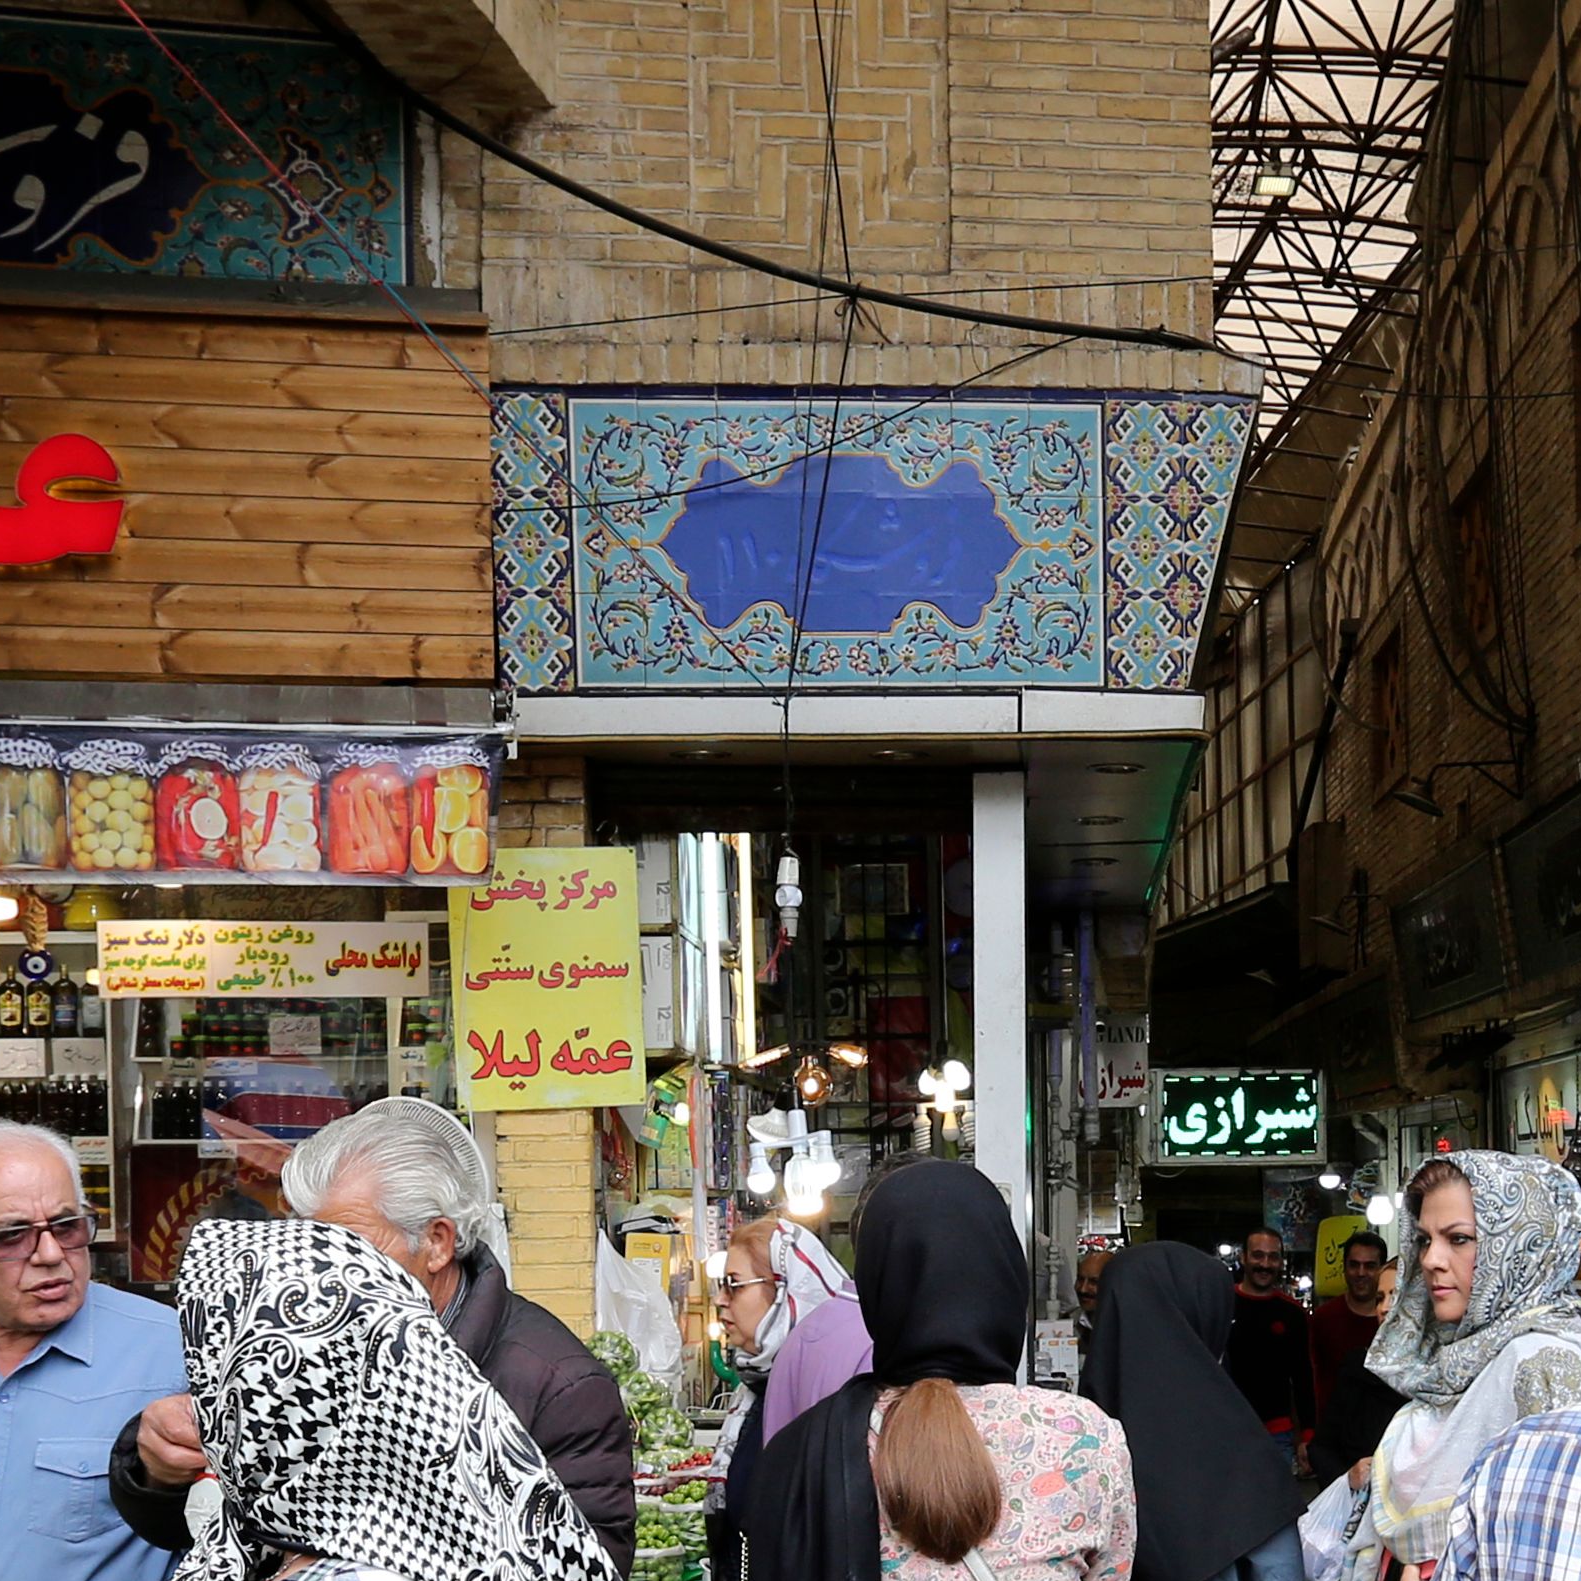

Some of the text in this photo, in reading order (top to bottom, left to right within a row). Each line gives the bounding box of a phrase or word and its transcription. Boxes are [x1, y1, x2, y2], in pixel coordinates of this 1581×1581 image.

[470, 869, 618, 912] مرکز پخش
[103, 931, 131, 952] سبز
[135, 931, 169, 946] نمک
[214, 925, 316, 945] روغن زیتون
[183, 955, 207, 971] برای
[235, 946, 290, 966] رودبار
[325, 942, 422, 977] لواشک محلی
[217, 968, 267, 991] طبیعی
[537, 955, 630, 989] سمنوی
[467, 1028, 542, 1091] لیلا
[1168, 1086, 1318, 1145] شیرازی
